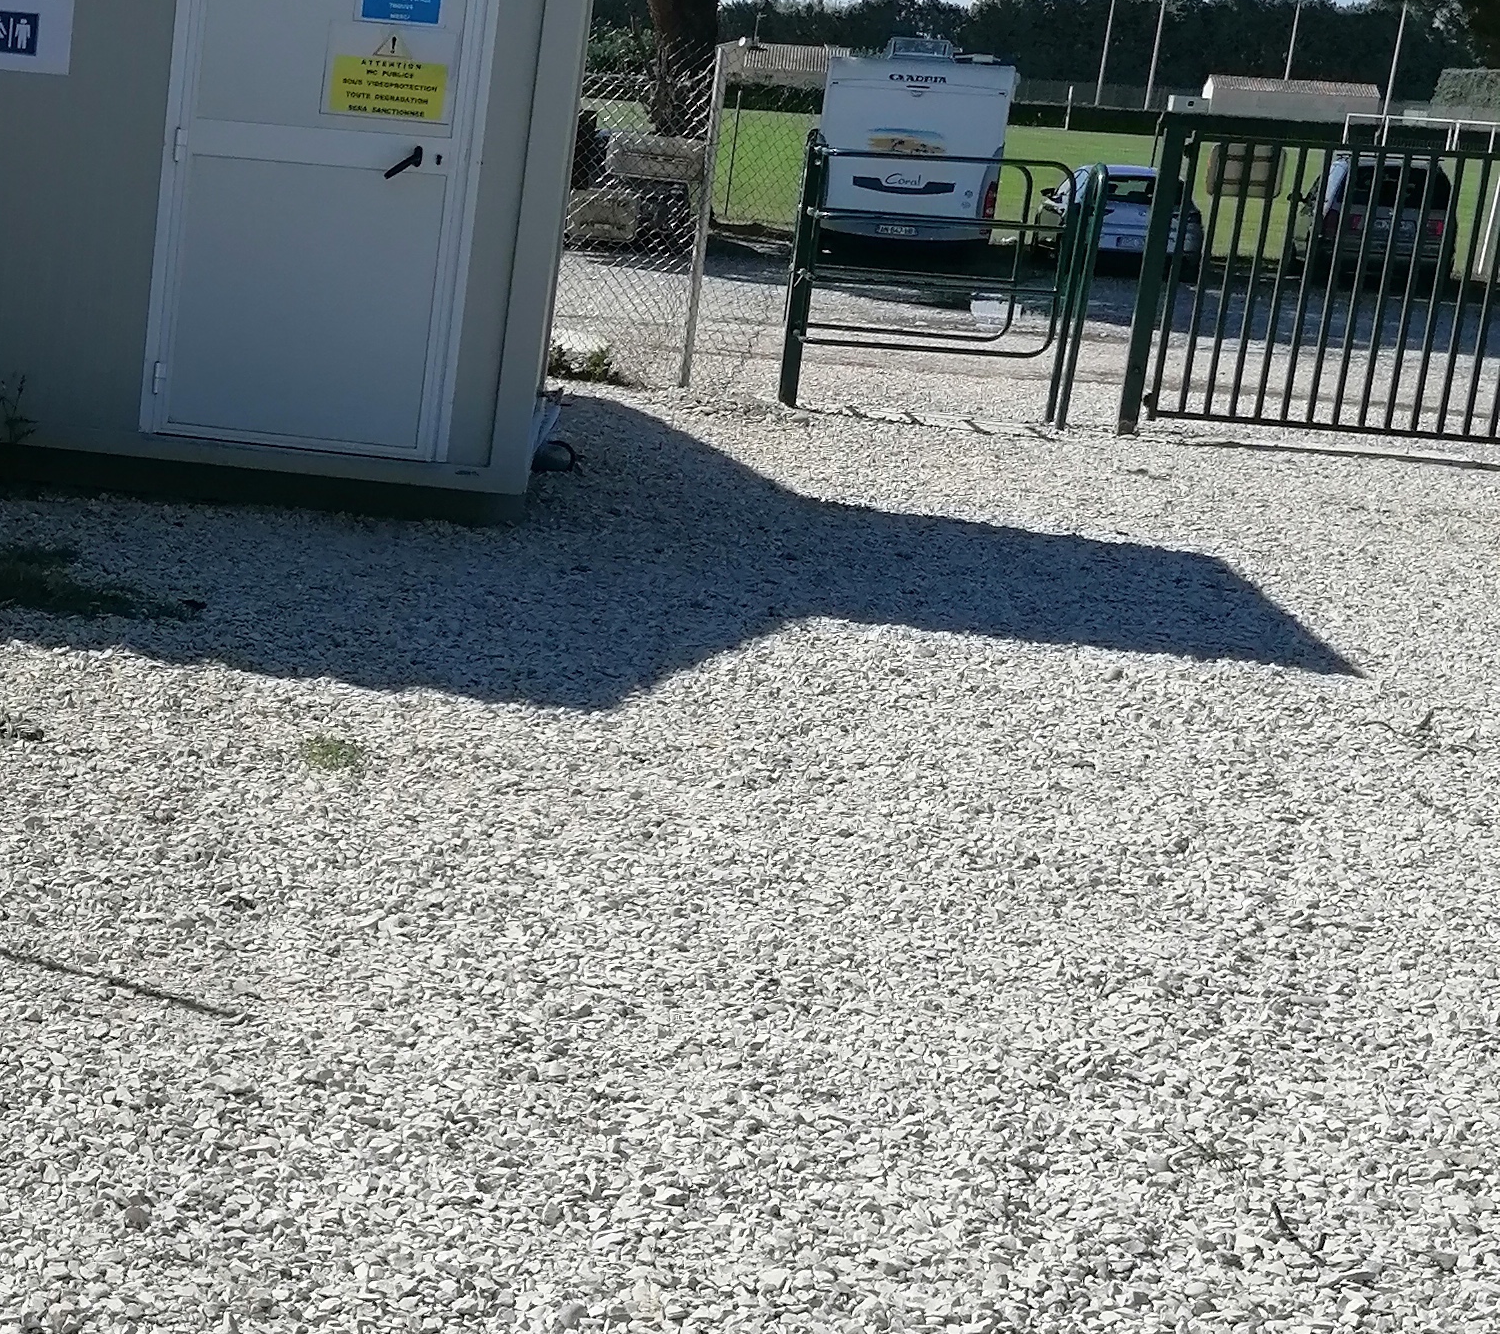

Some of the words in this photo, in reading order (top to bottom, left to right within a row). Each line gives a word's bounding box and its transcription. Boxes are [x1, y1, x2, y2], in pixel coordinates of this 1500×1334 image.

[361, 59, 422, 70] ATTENTION
[346, 91, 371, 99] TOUTE
[885, 172, 922, 186] Coral
